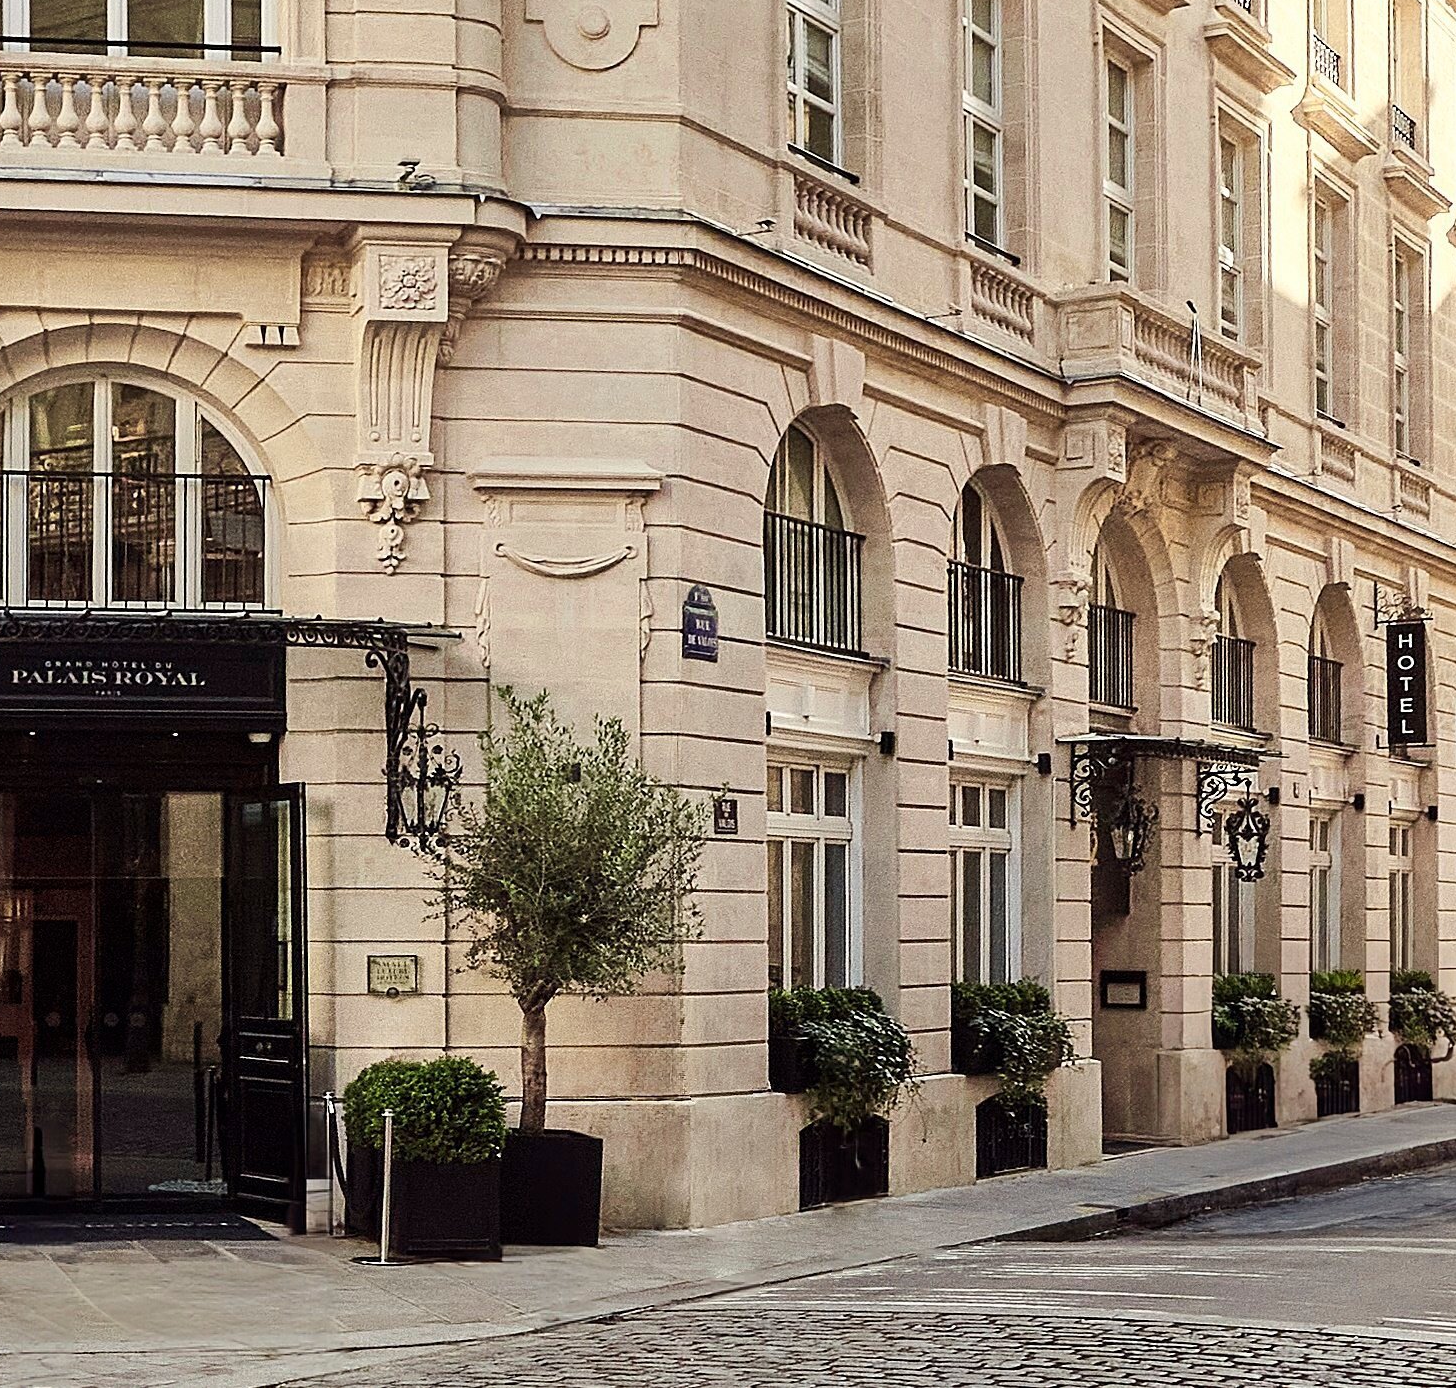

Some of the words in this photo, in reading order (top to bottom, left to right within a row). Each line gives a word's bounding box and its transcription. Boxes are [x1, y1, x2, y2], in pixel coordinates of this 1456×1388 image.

[695, 618, 711, 631] RUE
[687, 634, 697, 645] DE
[45, 660, 93, 668] GRAND
[155, 661, 173, 669] DU
[11, 670, 107, 684] PALAIS
[114, 671, 206, 686] ROYAL
[1397, 633, 1415, 734] HOTEL
